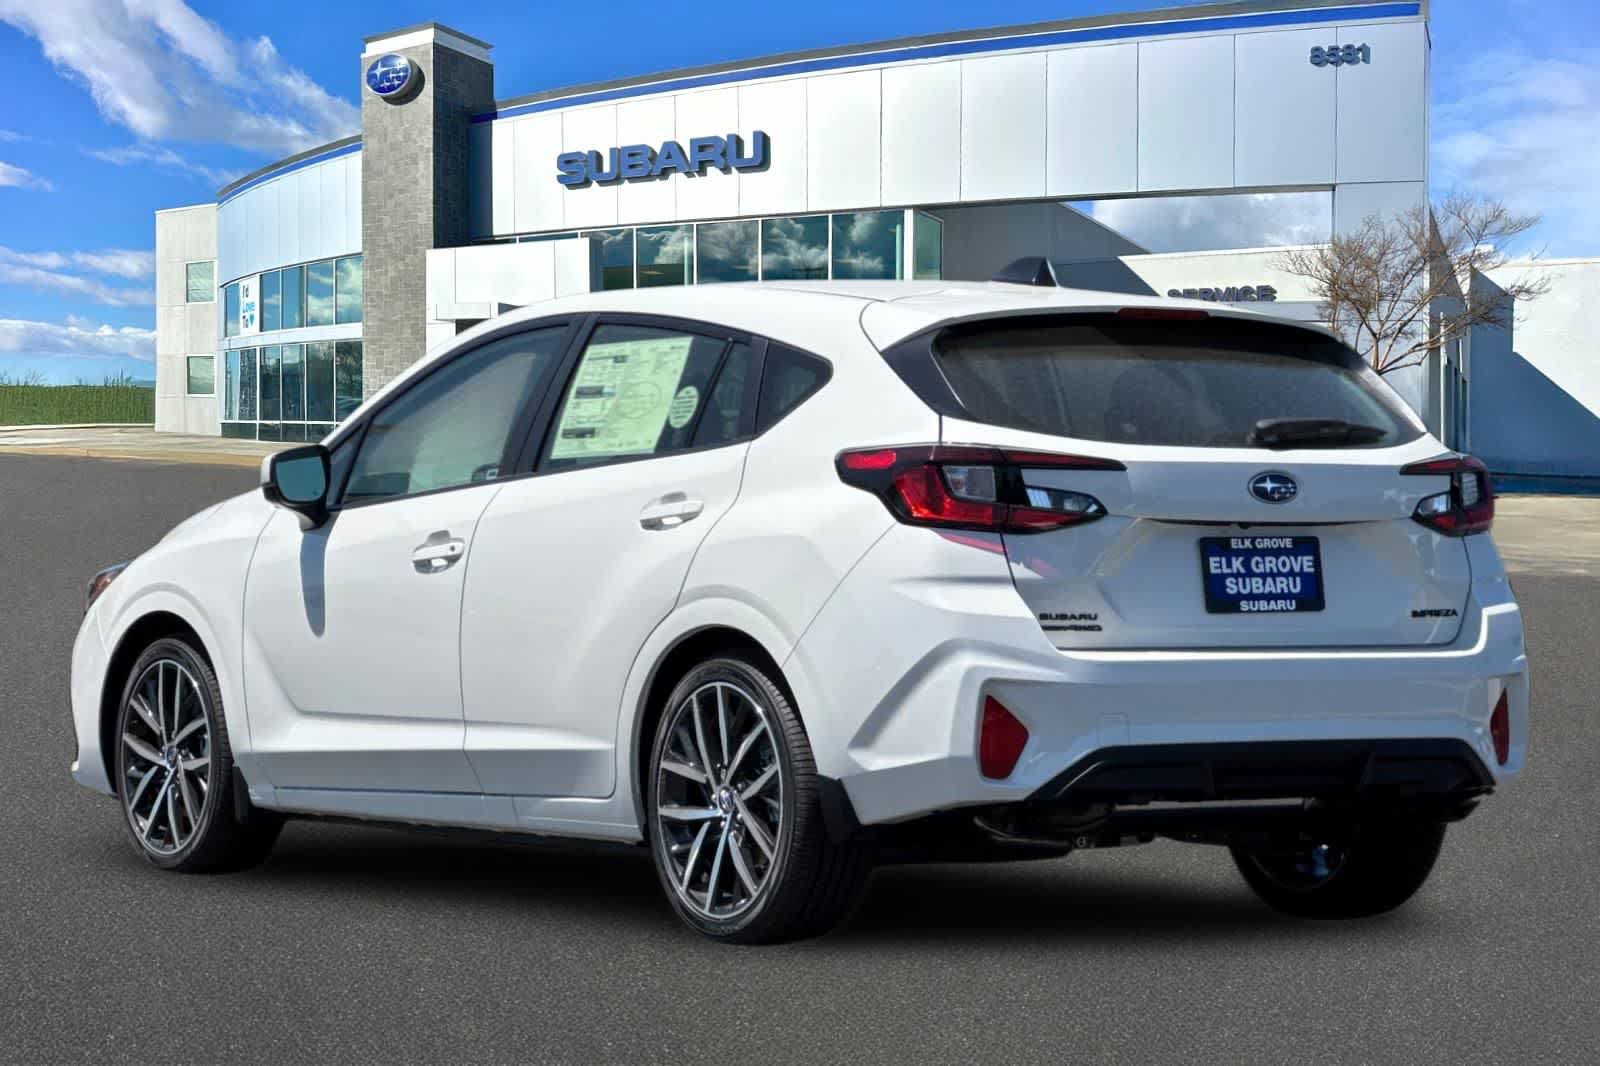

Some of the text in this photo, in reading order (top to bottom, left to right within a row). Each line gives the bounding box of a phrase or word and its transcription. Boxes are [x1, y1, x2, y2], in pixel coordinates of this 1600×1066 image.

[1310, 43, 1370, 67] 8581
[557, 130, 769, 189] SUBARU
[1231, 538, 1293, 548] ELK GROVE
[1209, 556, 1314, 574] ELK GROVE
[1225, 577, 1301, 594] SUBARU
[1240, 600, 1296, 611] SUBARU
